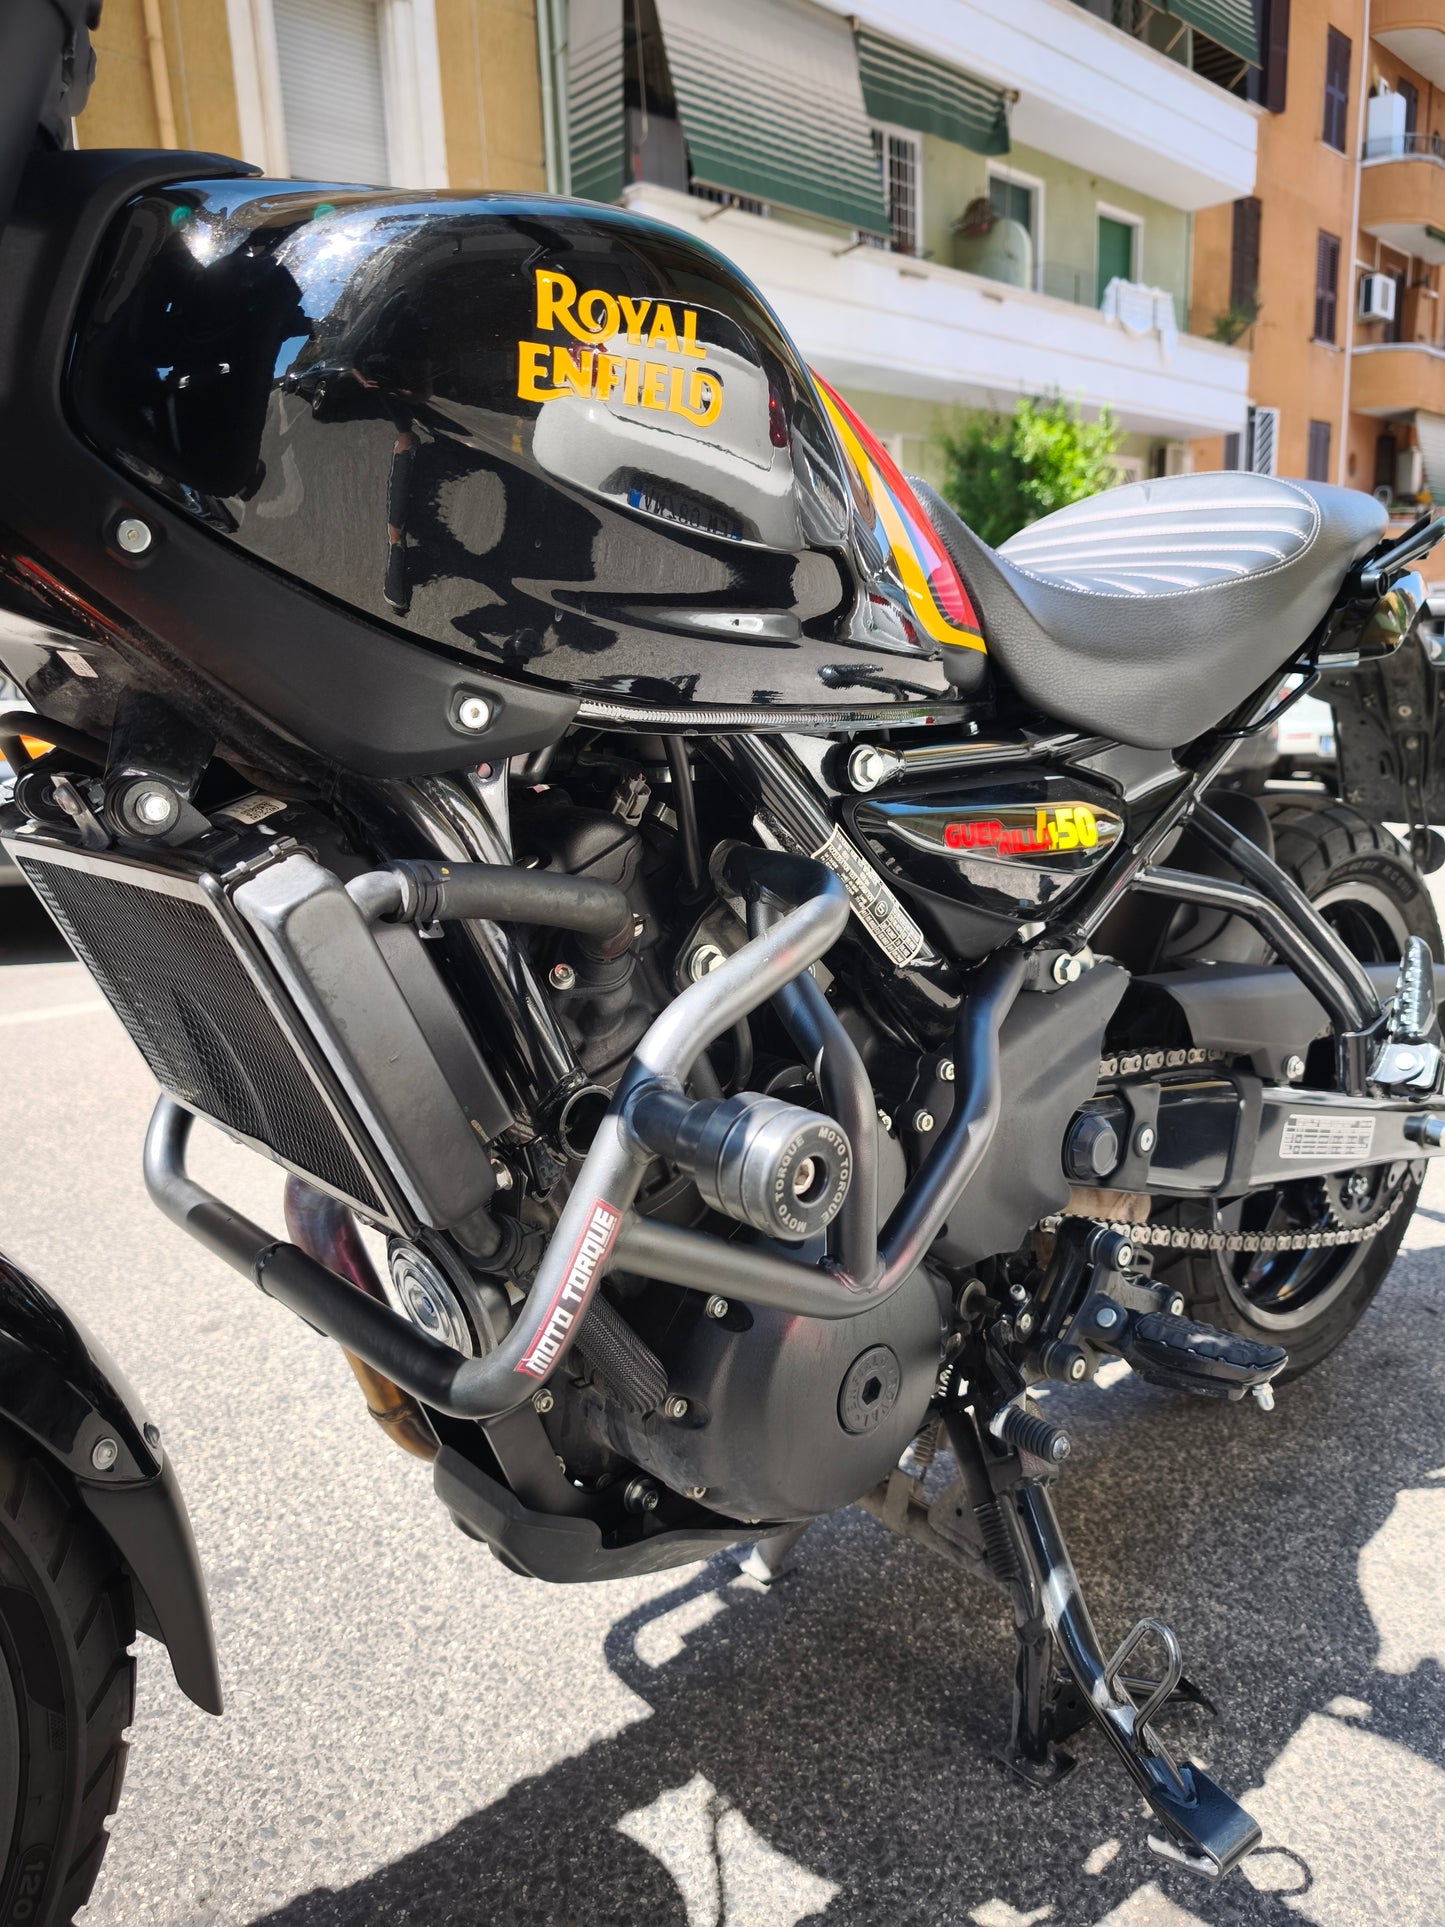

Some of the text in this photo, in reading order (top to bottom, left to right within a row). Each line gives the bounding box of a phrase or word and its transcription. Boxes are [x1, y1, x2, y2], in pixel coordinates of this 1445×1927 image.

[535, 269, 707, 360] ROYAL
[517, 341, 723, 428] ENFIELD
[775, 1135, 807, 1233] MOTO TORQUE
[818, 1126, 849, 1223] MOTO TORQUE
[525, 1206, 616, 1375] MOTO TORQUE
[13, 1861, 45, 1920] 120
